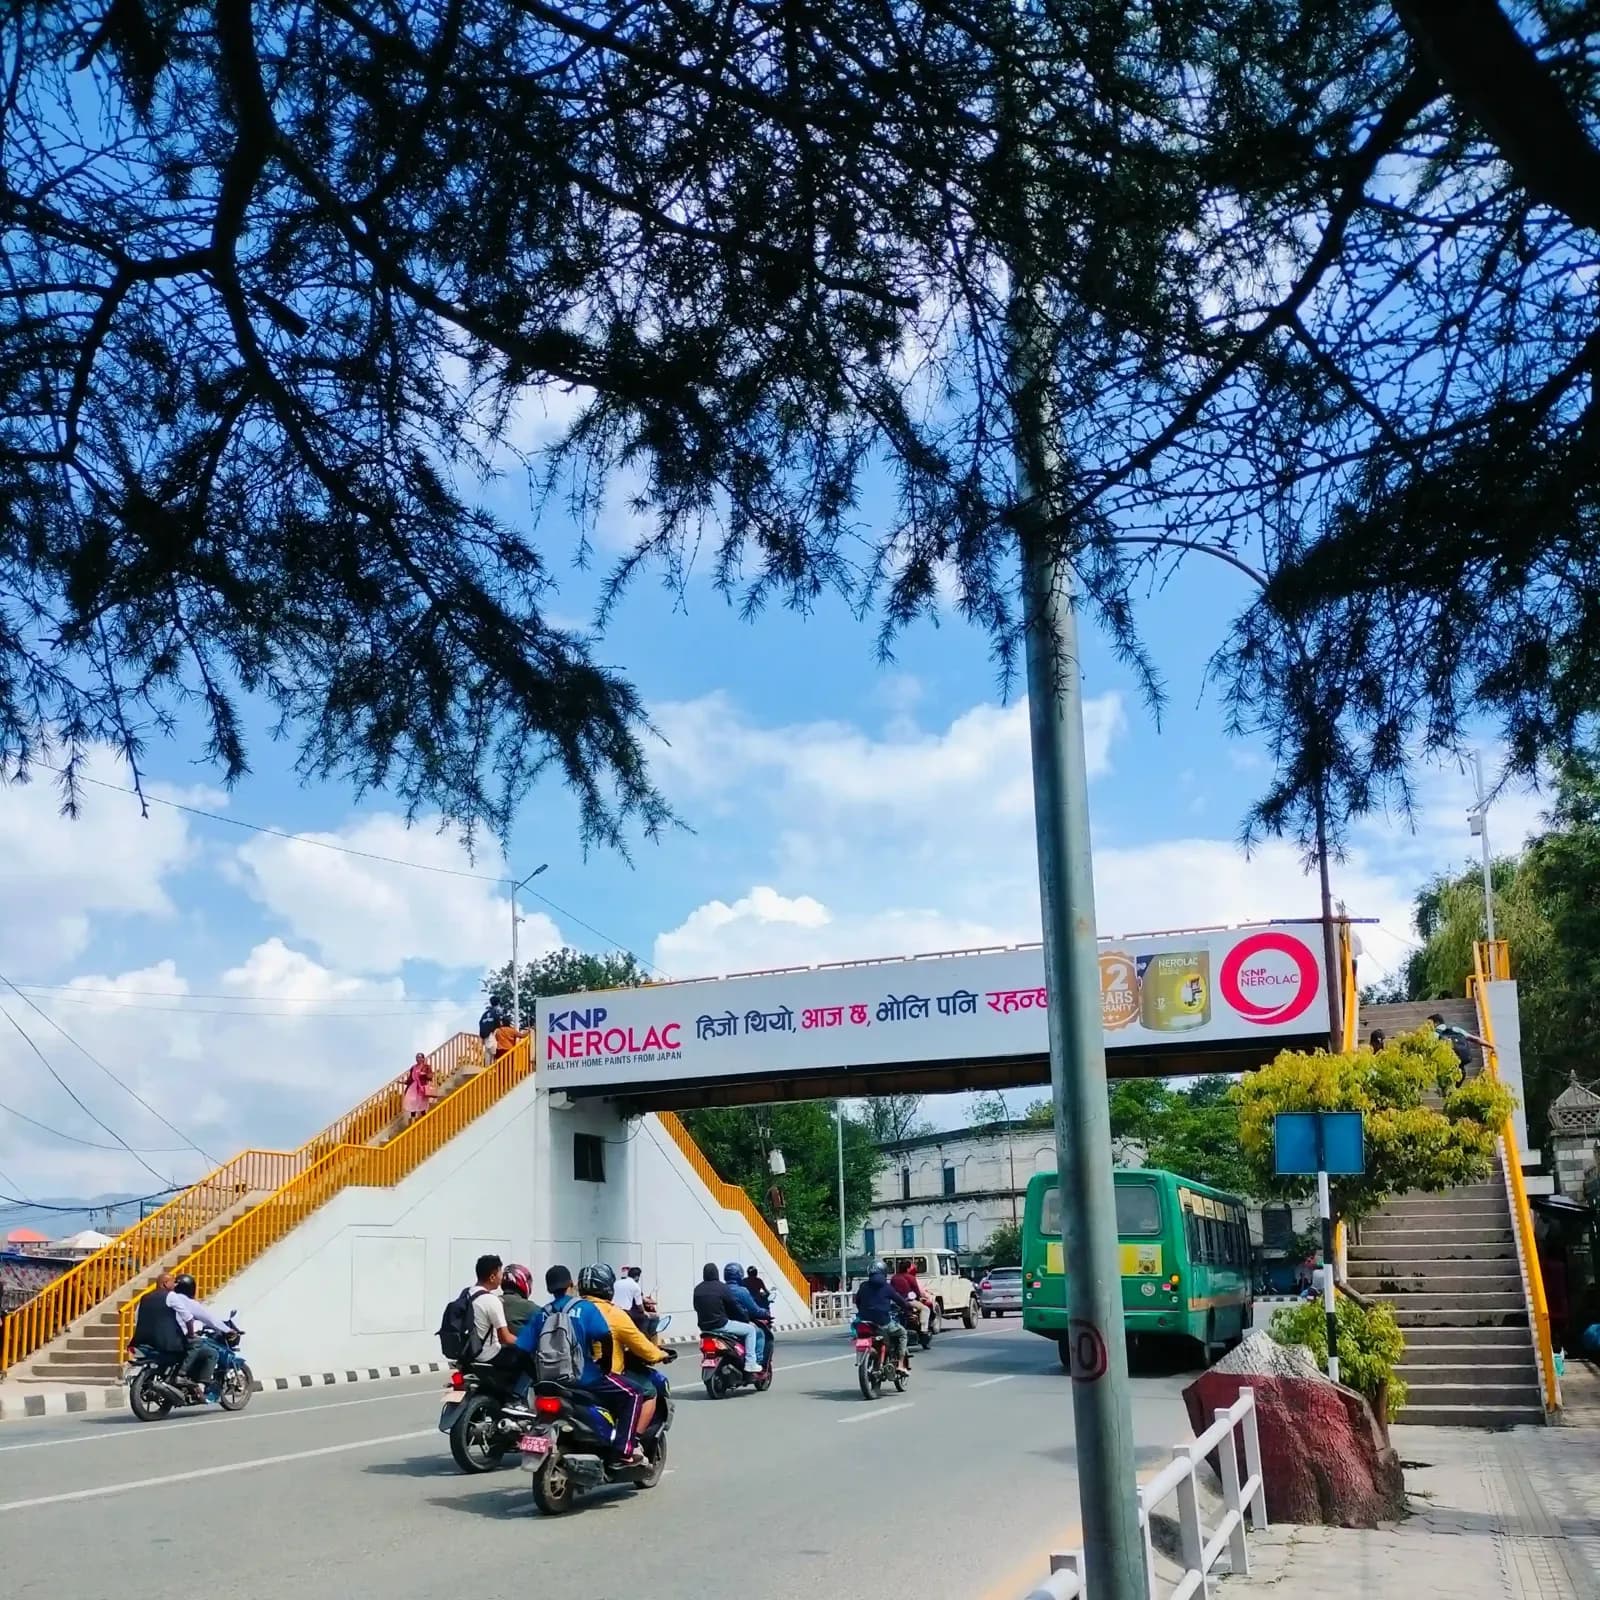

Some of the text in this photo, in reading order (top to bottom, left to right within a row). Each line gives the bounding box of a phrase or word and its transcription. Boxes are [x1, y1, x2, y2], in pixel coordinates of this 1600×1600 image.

[1158, 957, 1199, 969] NEROLAC
[1241, 968, 1267, 978] KNP
[1240, 973, 1299, 987] NEROLAC
[548, 1007, 608, 1033] KNP
[696, 1010, 739, 1040] हिजो
[744, 1005, 797, 1034] थियो,
[801, 1006, 845, 1030] आज
[876, 994, 931, 1022] भोलि
[936, 989, 979, 1017] पनि
[547, 1023, 682, 1060] NEROLAC
[547, 1051, 682, 1071] HEALTHY HOME PAINTS FROM JAPAN
